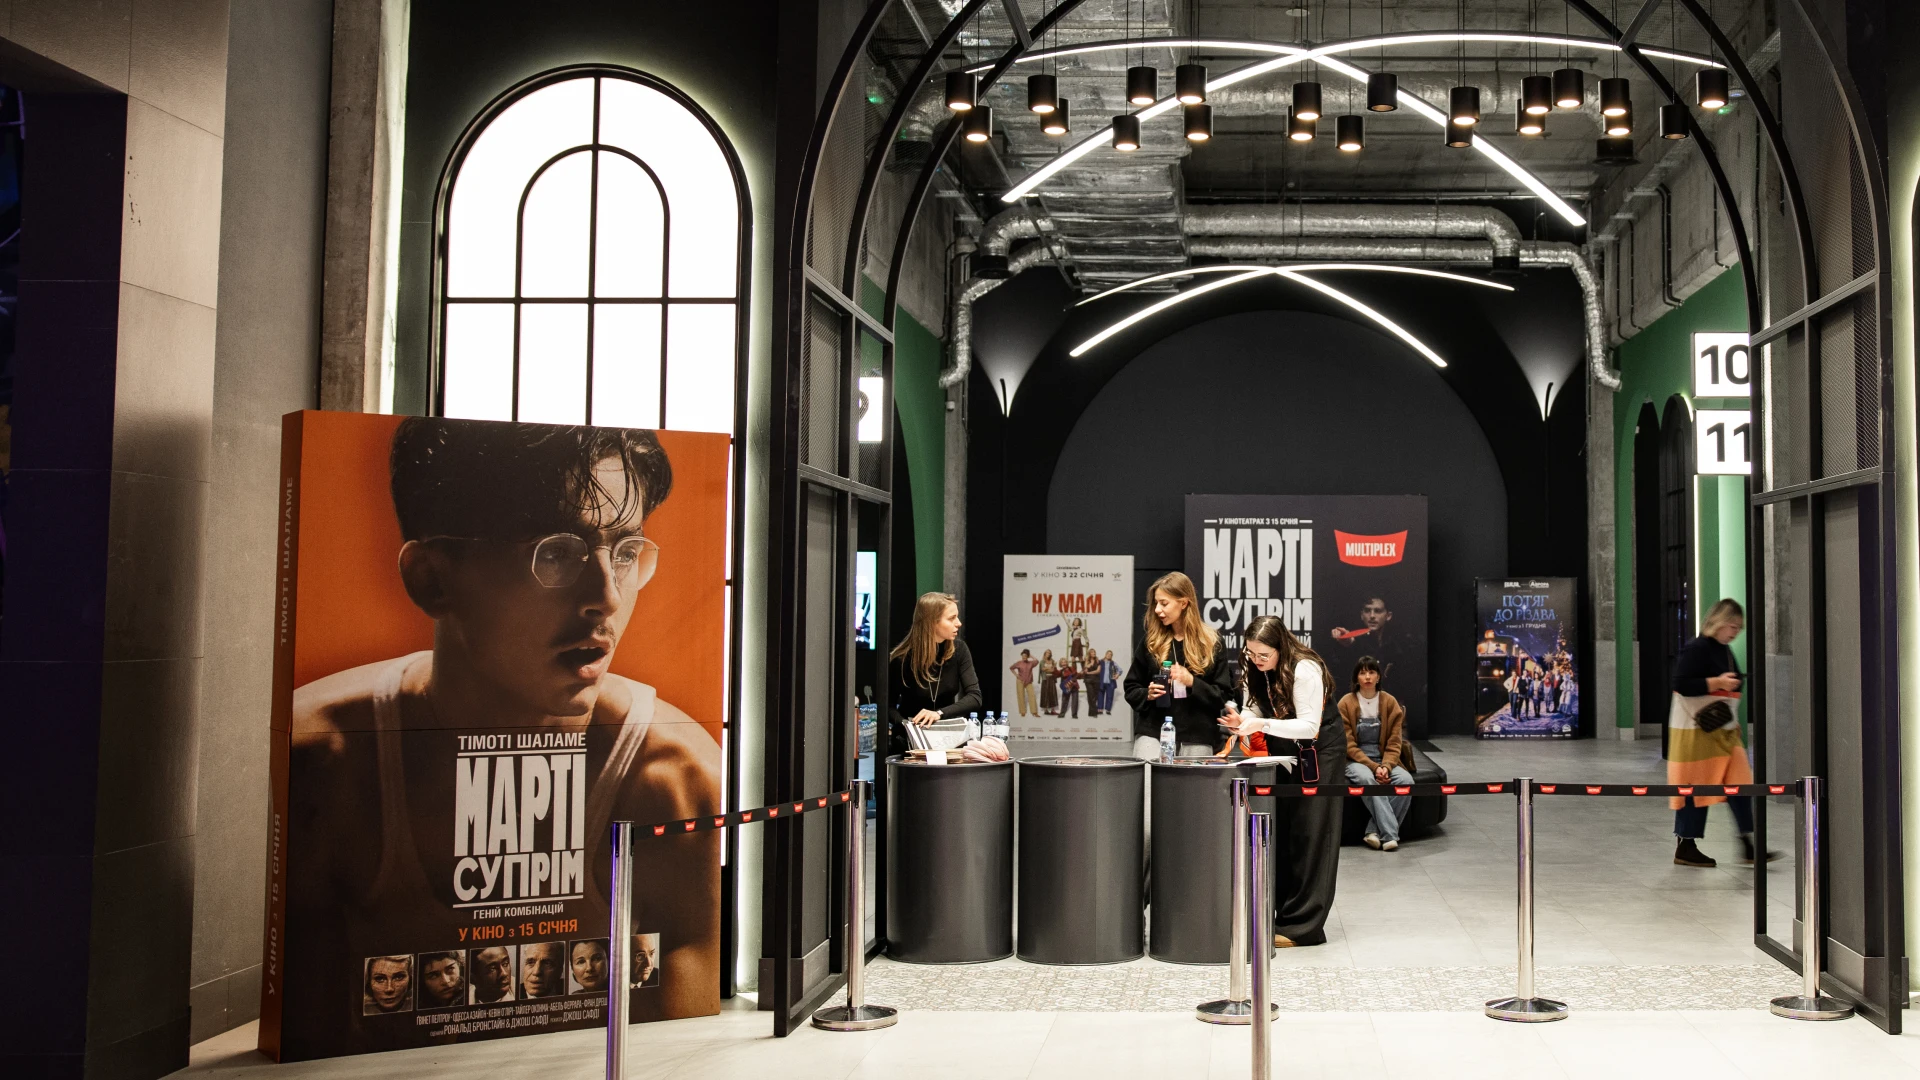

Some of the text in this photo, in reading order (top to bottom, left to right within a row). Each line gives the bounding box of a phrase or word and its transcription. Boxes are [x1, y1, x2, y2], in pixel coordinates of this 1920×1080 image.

[1700, 344, 1750, 385] 10
[1706, 422, 1751, 463] 11
[1345, 542, 1396, 557] MULTIPLEX
[280, 477, 293, 647] ТІМОТІ ШАЛАМЕ
[1203, 528, 1313, 599] МАРТІ
[1032, 593, 1102, 614] НУ МАМ
[1502, 595, 1549, 607] ПОТЯГ
[1494, 609, 1556, 622] ДО РІЗДВА
[458, 732, 586, 751] ТІМОТІ ШАЛАМЕ
[454, 754, 586, 857] МАРТІ
[273, 814, 281, 875] СІЧНЯ
[453, 850, 584, 902] СУПРІМ
[272, 883, 279, 904] 15
[473, 902, 564, 920] ГЕНІЙ КОМБІНАЦІЙ
[458, 924, 469, 941] У
[472, 923, 504, 941] КІНО
[520, 922, 535, 937] 15
[538, 918, 578, 936] СІЧНЯ
[268, 983, 276, 995] У
[452, 1012, 470, 1022] ОДЕССА
[550, 1002, 563, 1012] АБЕЛЬ
[564, 1000, 582, 1010] ФЕРРАРА
[584, 998, 596, 1008] ФРАН
[596, 997, 608, 1007] ДРЕШ
[444, 1023, 472, 1036] РОНАЛЬД
[472, 1018, 505, 1032] БРОНСТАЙН
[506, 1018, 510, 1028] &
[511, 1016, 530, 1028] ДЖОШ
[530, 1014, 548, 1026] САФДІ
[562, 1010, 582, 1022] ДЖОШ
[582, 1008, 600, 1020] САФДІ
